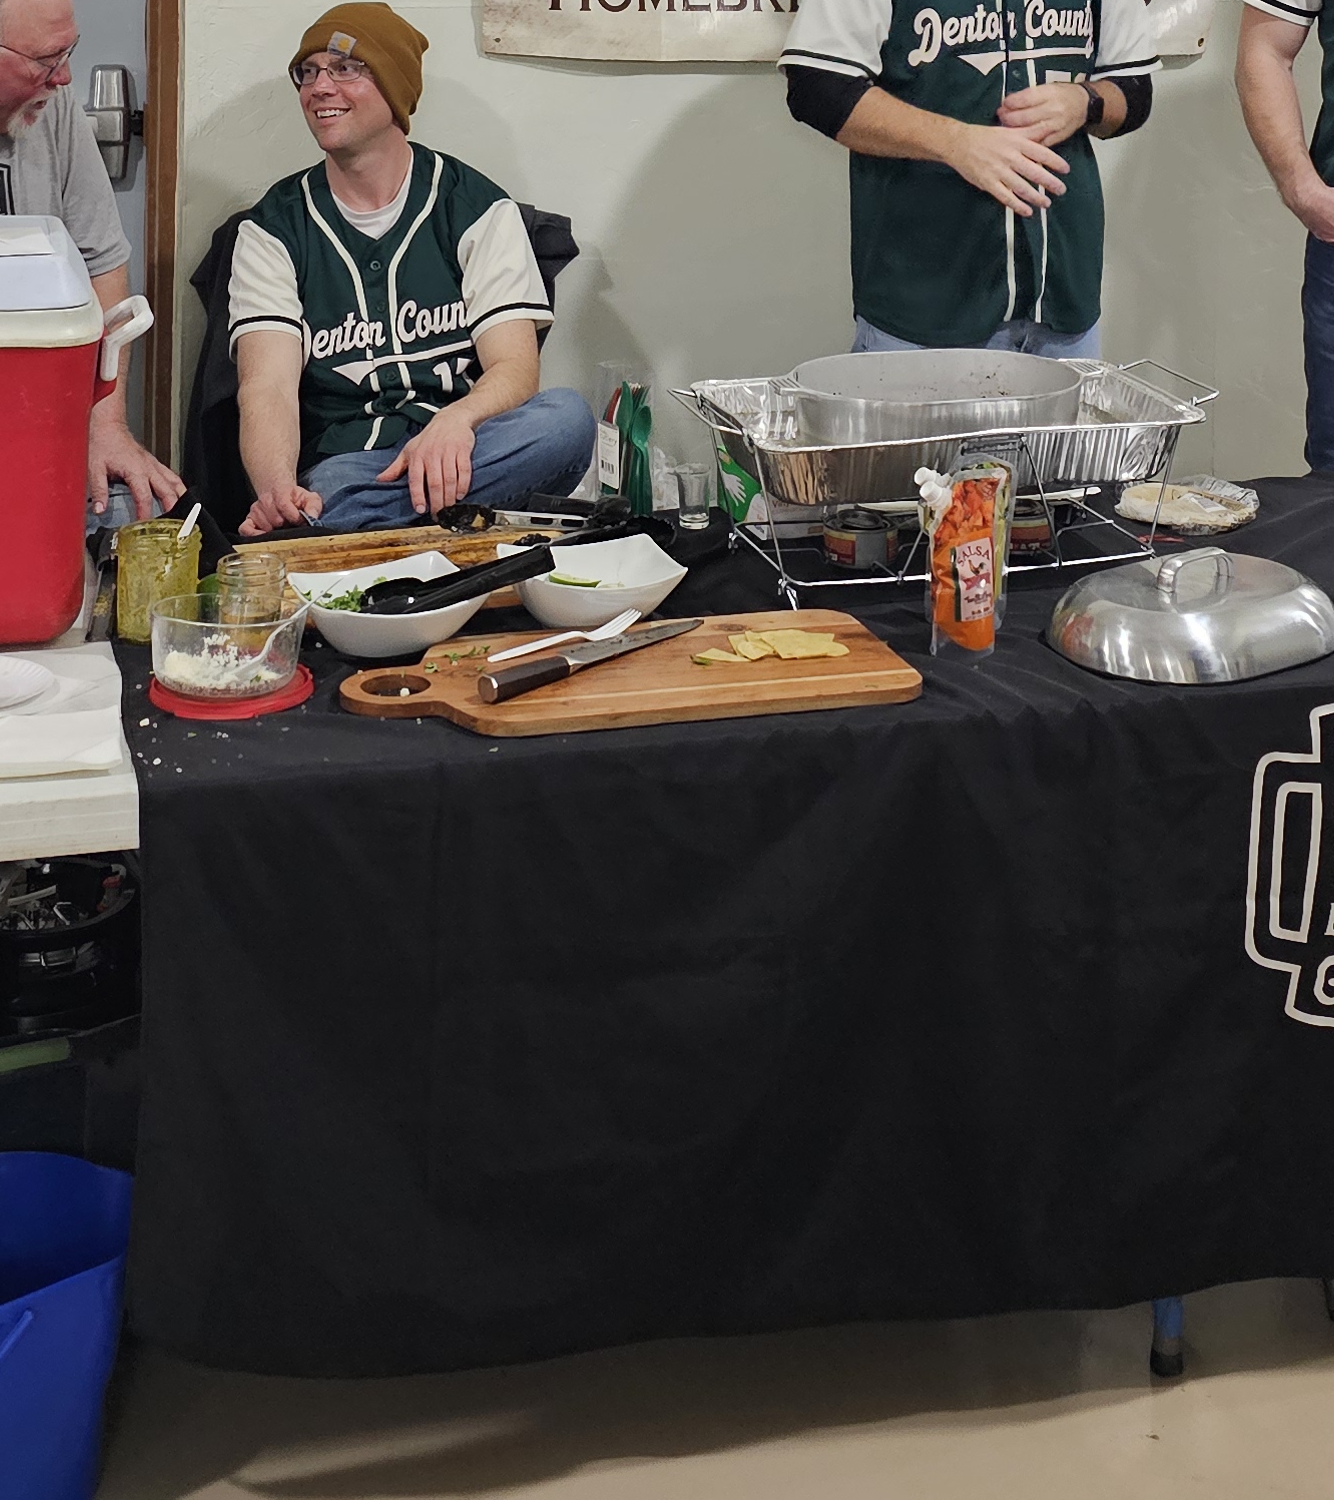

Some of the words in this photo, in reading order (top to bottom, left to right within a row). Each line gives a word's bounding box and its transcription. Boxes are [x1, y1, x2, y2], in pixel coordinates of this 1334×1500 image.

[908, 3, 1017, 67] Denton
[397, 300, 470, 343] Coun
[957, 545, 990, 567] SALSA
